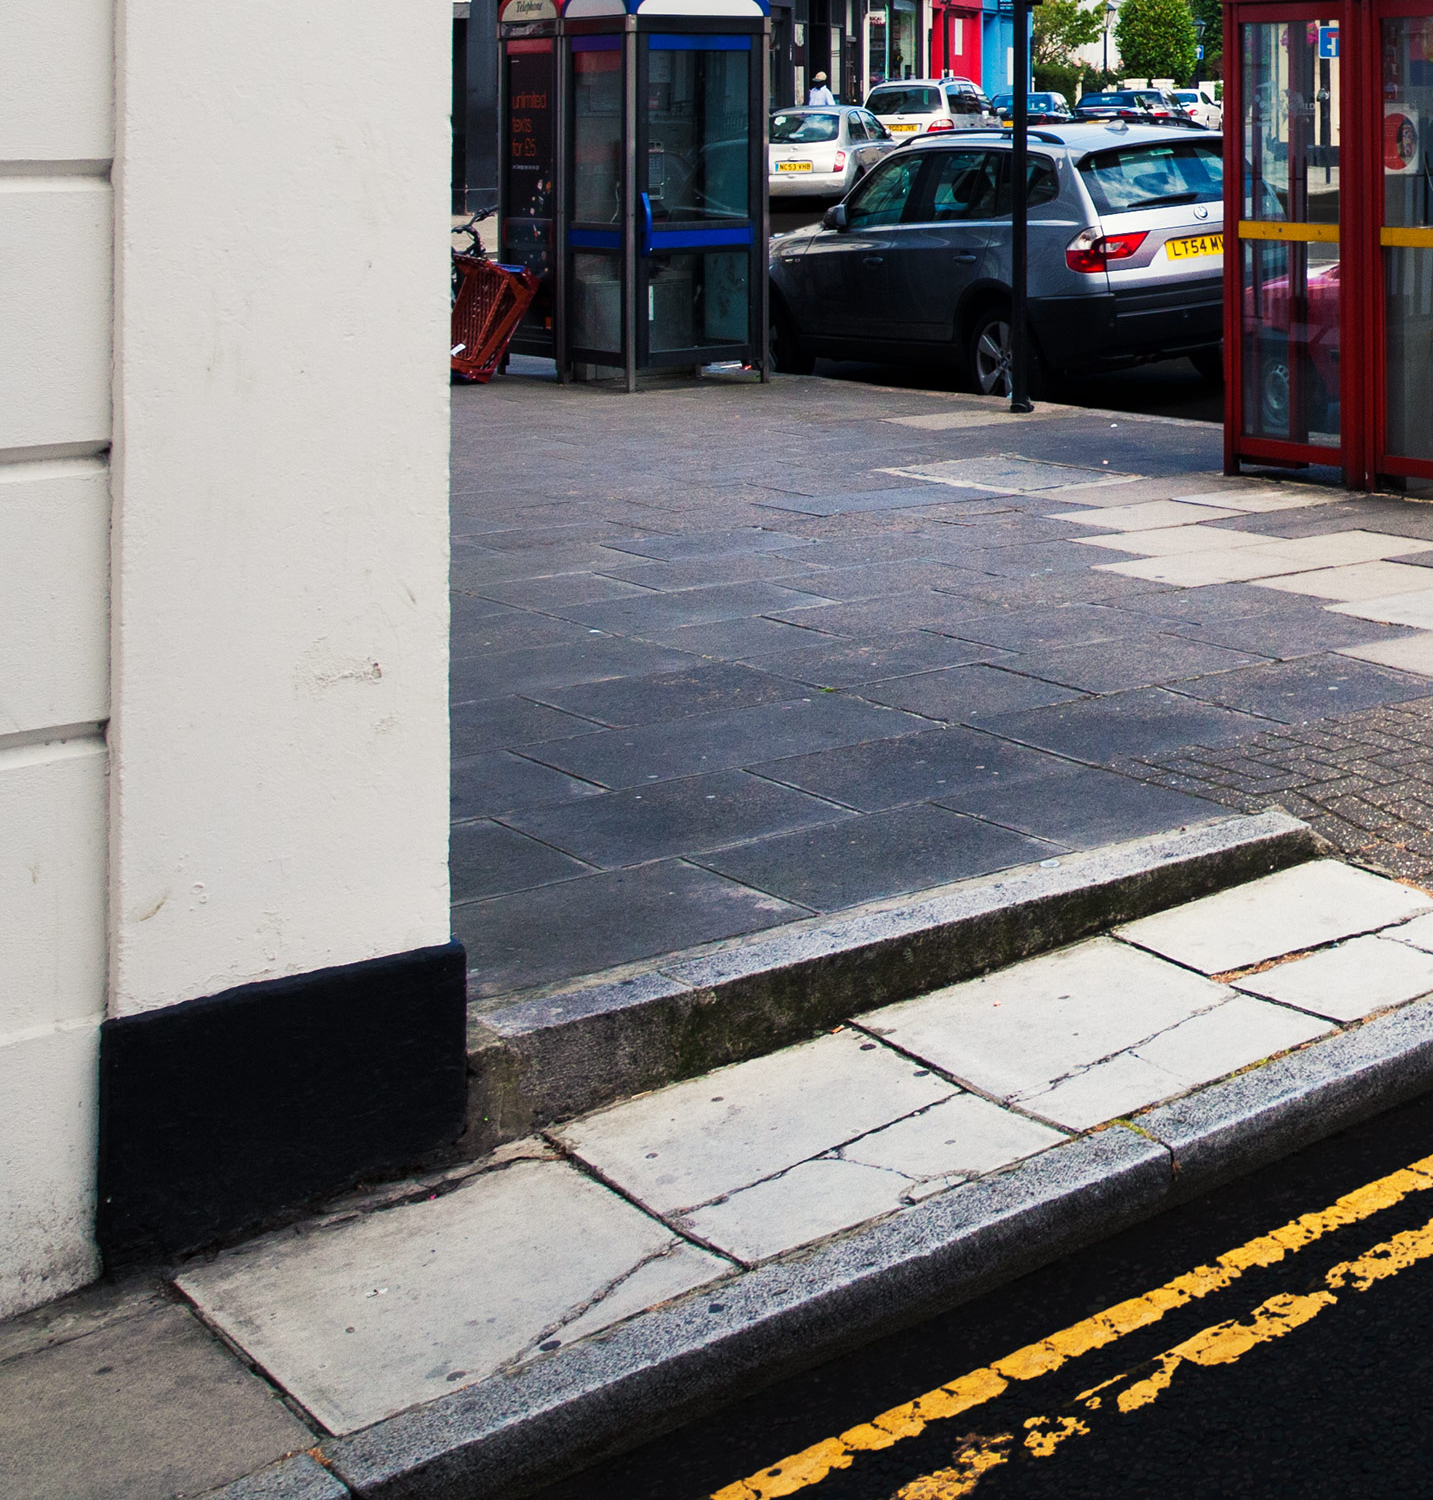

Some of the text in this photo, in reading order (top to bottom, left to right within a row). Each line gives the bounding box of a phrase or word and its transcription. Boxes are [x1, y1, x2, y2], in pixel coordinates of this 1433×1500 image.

[516, 0, 543, 15] Telephone
[512, 91, 547, 109] unlimited
[512, 117, 532, 133] texts
[512, 137, 537, 157] for £5
[1172, 238, 1207, 256] LT54
